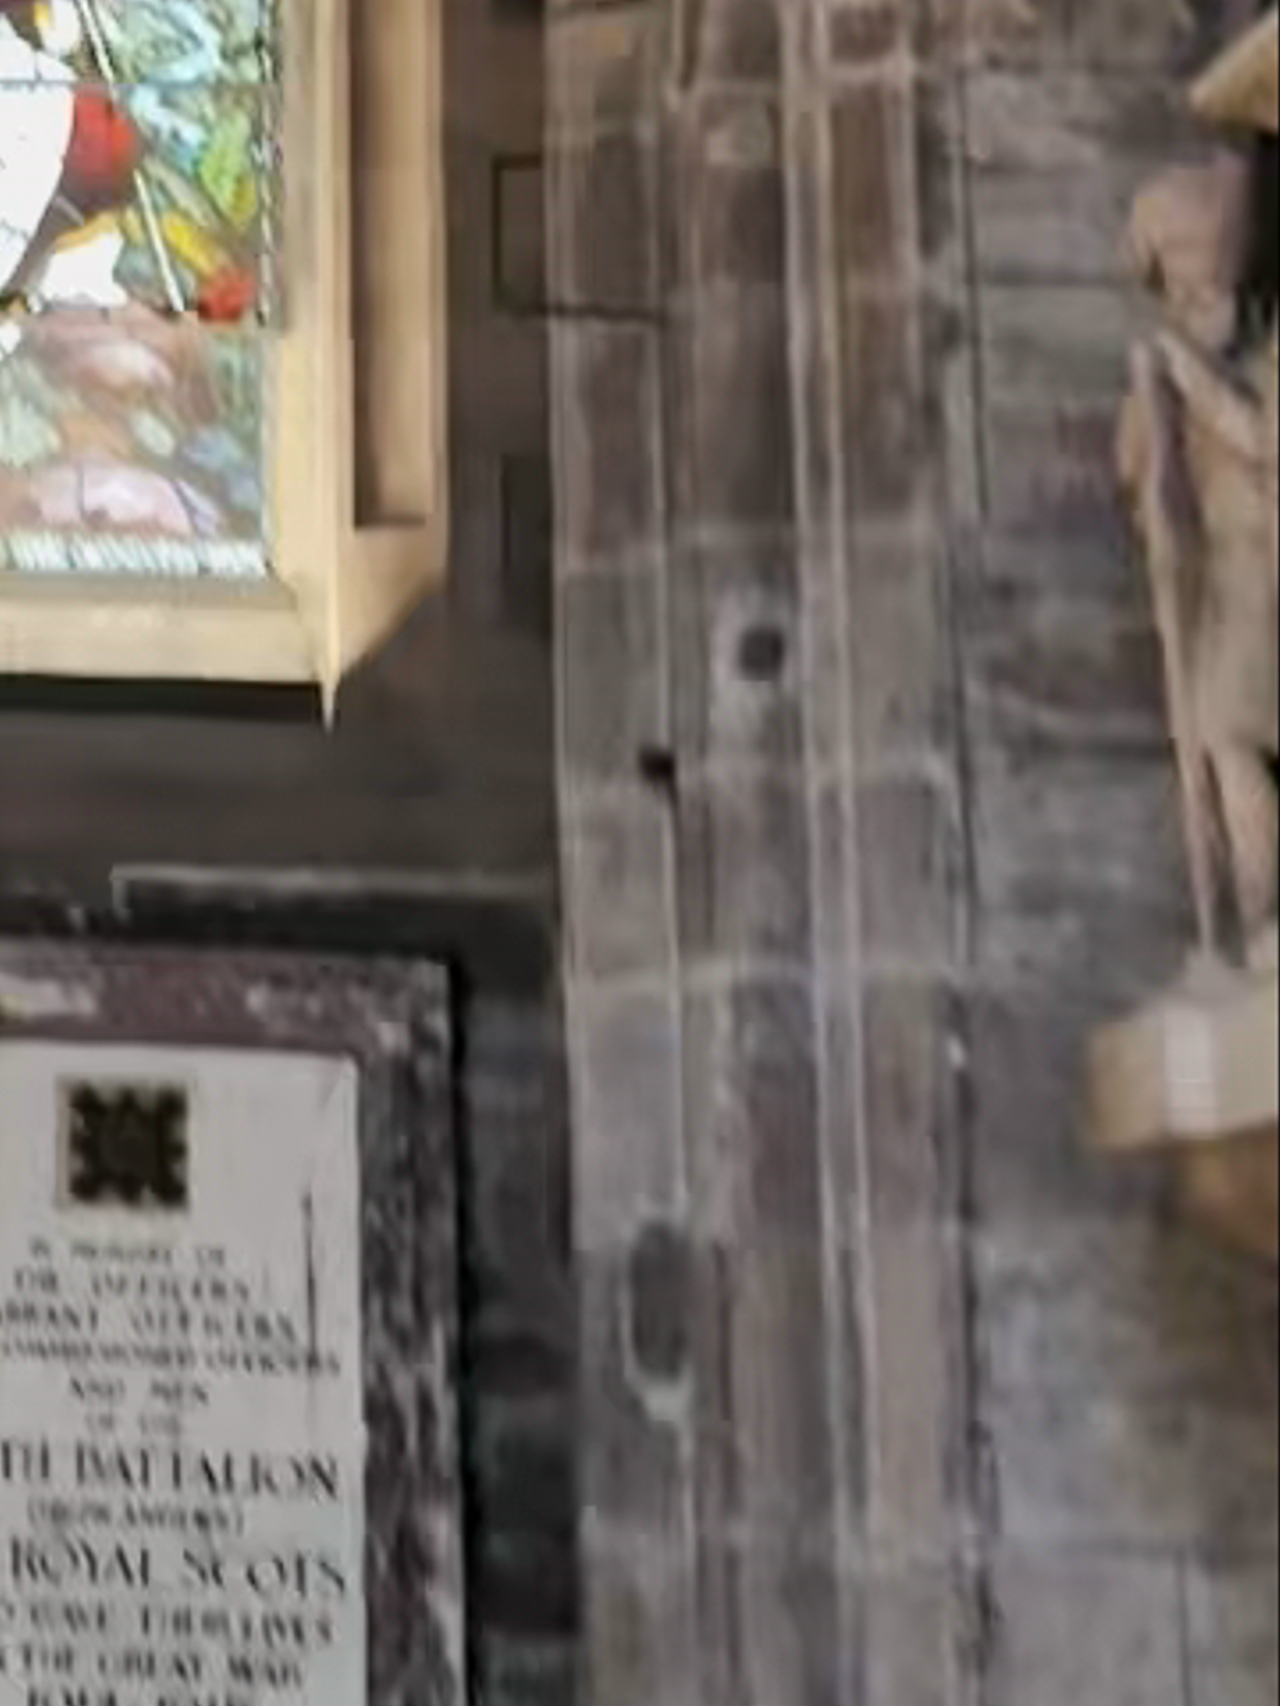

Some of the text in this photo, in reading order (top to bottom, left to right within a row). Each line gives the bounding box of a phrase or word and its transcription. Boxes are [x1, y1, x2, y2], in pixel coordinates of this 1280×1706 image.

[75, 1439, 338, 1500] BATTALION
[11, 1534, 151, 1588] ROYAL
[182, 1546, 346, 1598] SCOTS
